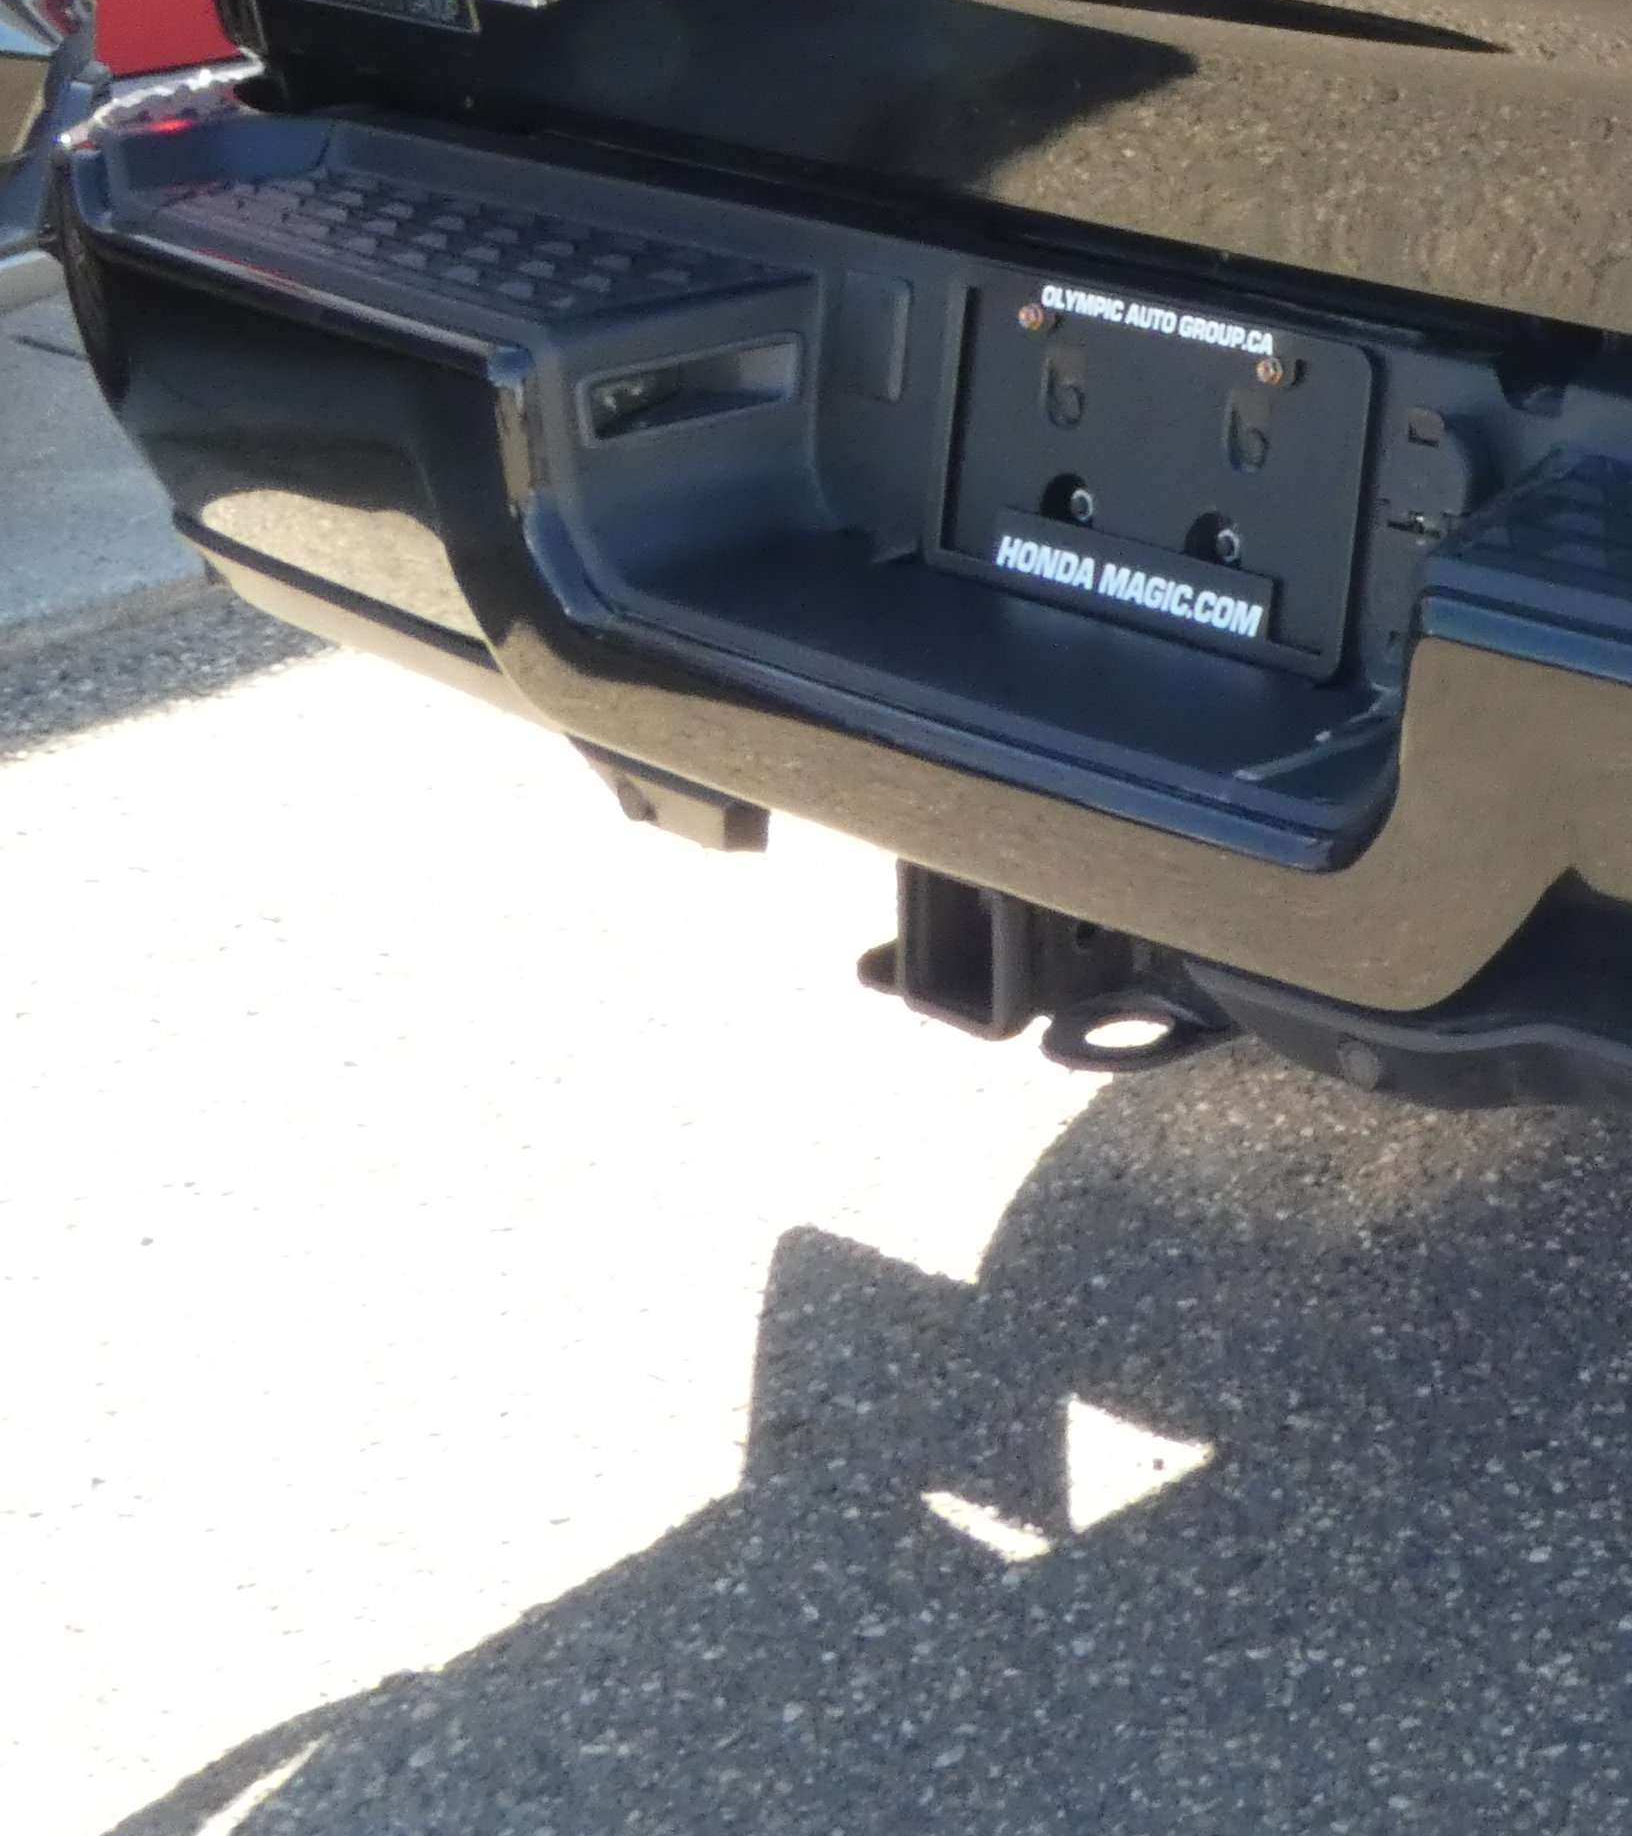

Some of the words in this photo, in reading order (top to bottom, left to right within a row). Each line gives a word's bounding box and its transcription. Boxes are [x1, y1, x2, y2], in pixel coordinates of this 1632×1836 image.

[1040, 283, 1126, 324] OLYMPIC
[1123, 304, 1178, 336] AUTO
[1176, 314, 1275, 357] GROUP.CA
[996, 535, 1096, 592] HONDA
[1096, 562, 1265, 639] MAGIC.COM
